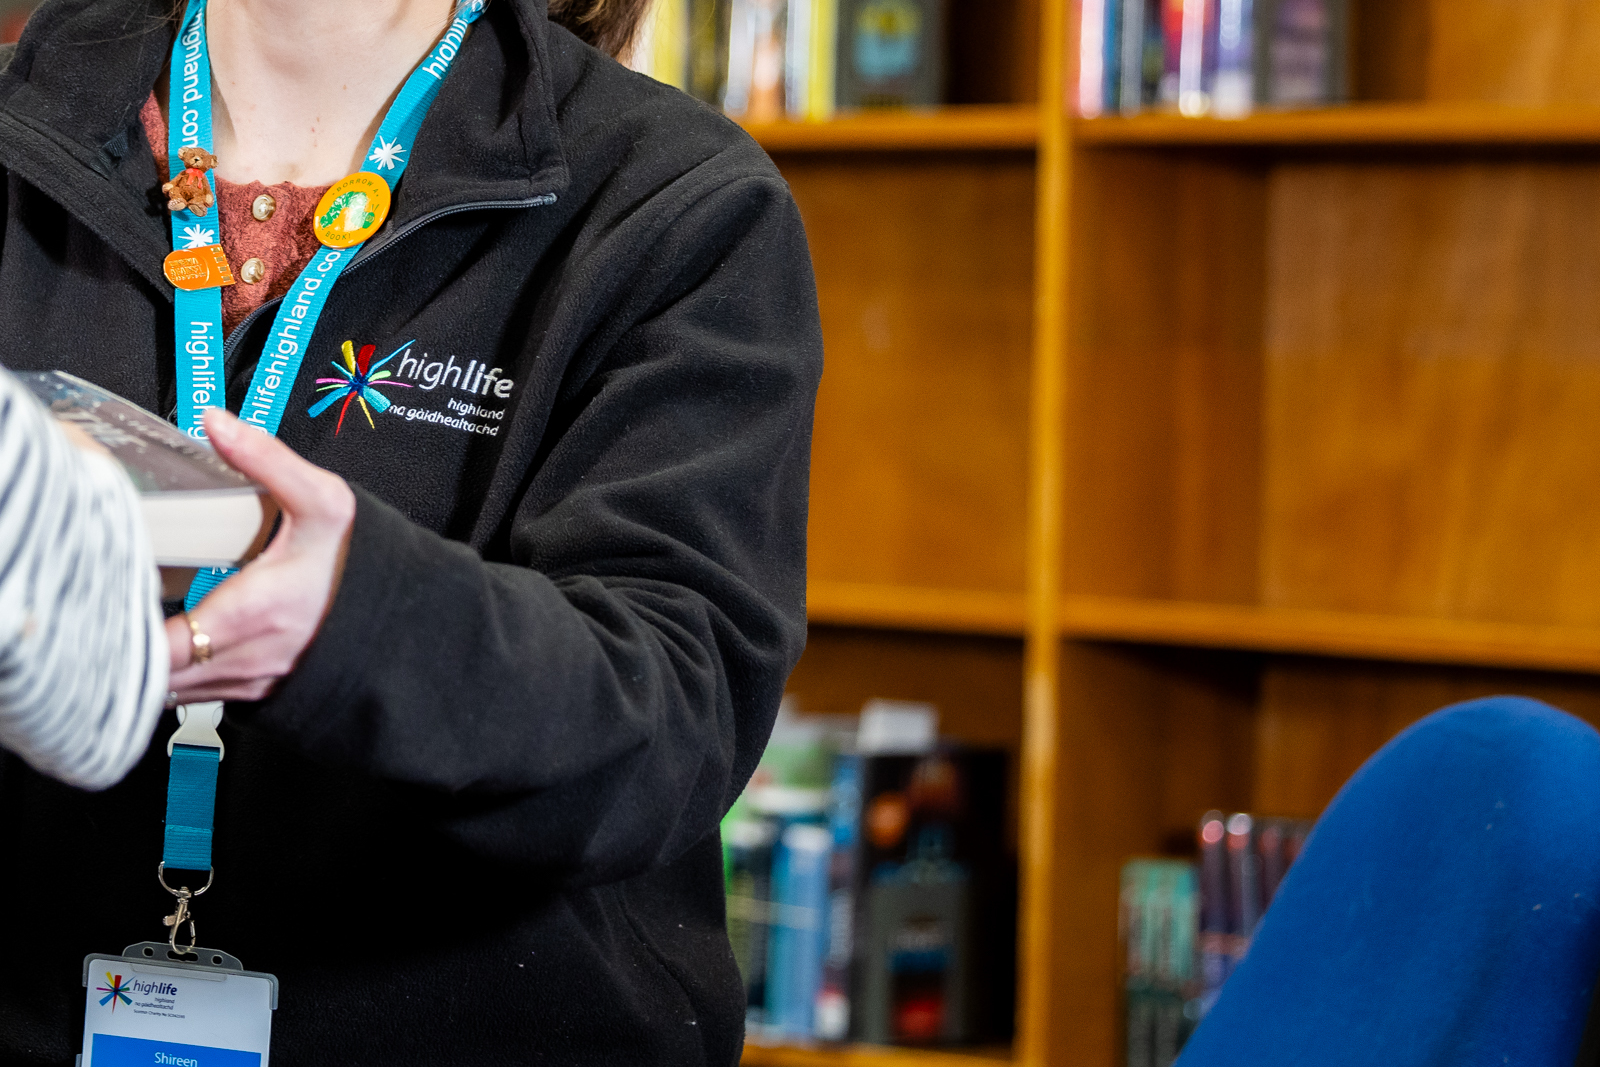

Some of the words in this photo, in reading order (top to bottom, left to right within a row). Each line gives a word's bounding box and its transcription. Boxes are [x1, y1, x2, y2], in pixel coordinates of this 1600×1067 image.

[246, 248, 345, 435] hlifehighland.co
[396, 348, 515, 399] highlife
[388, 404, 406, 416] na
[447, 397, 506, 420] highland
[132, 979, 178, 996] highlife
[154, 1051, 198, 1067] Shireen
